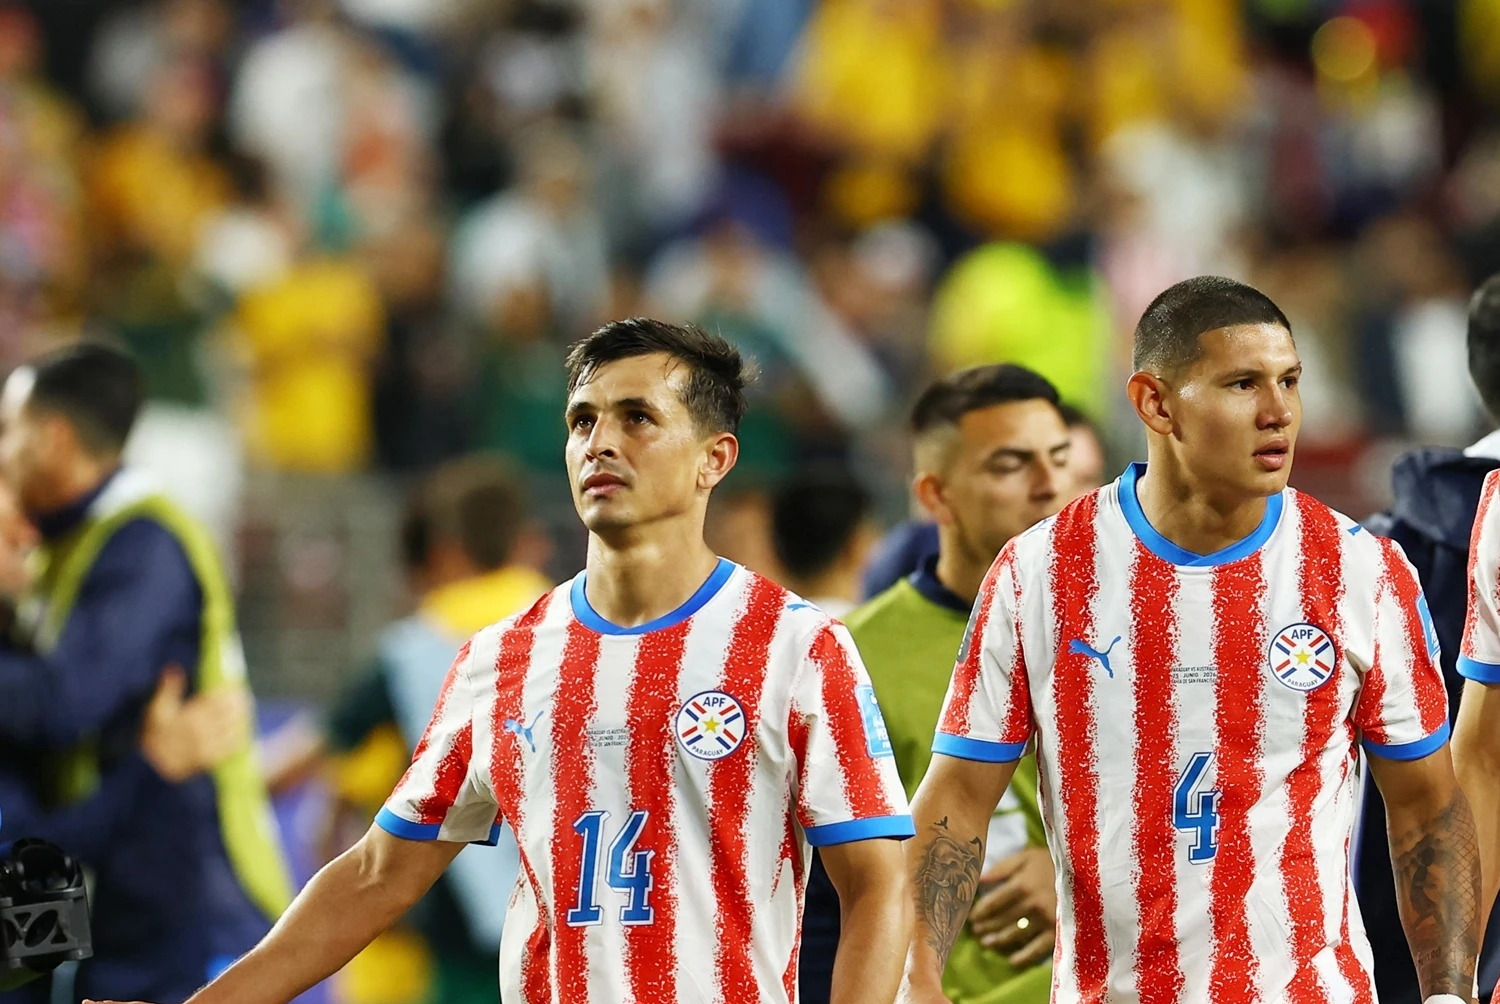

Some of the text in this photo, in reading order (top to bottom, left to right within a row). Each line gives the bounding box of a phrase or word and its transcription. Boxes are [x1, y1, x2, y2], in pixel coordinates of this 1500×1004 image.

[1291, 629, 1314, 640] APF
[1287, 678, 1318, 688] PARAGUAY
[702, 696, 726, 707] APF
[691, 745, 724, 757] PARAGUAY
[1171, 752, 1222, 866] 4
[567, 810, 656, 927] 14
